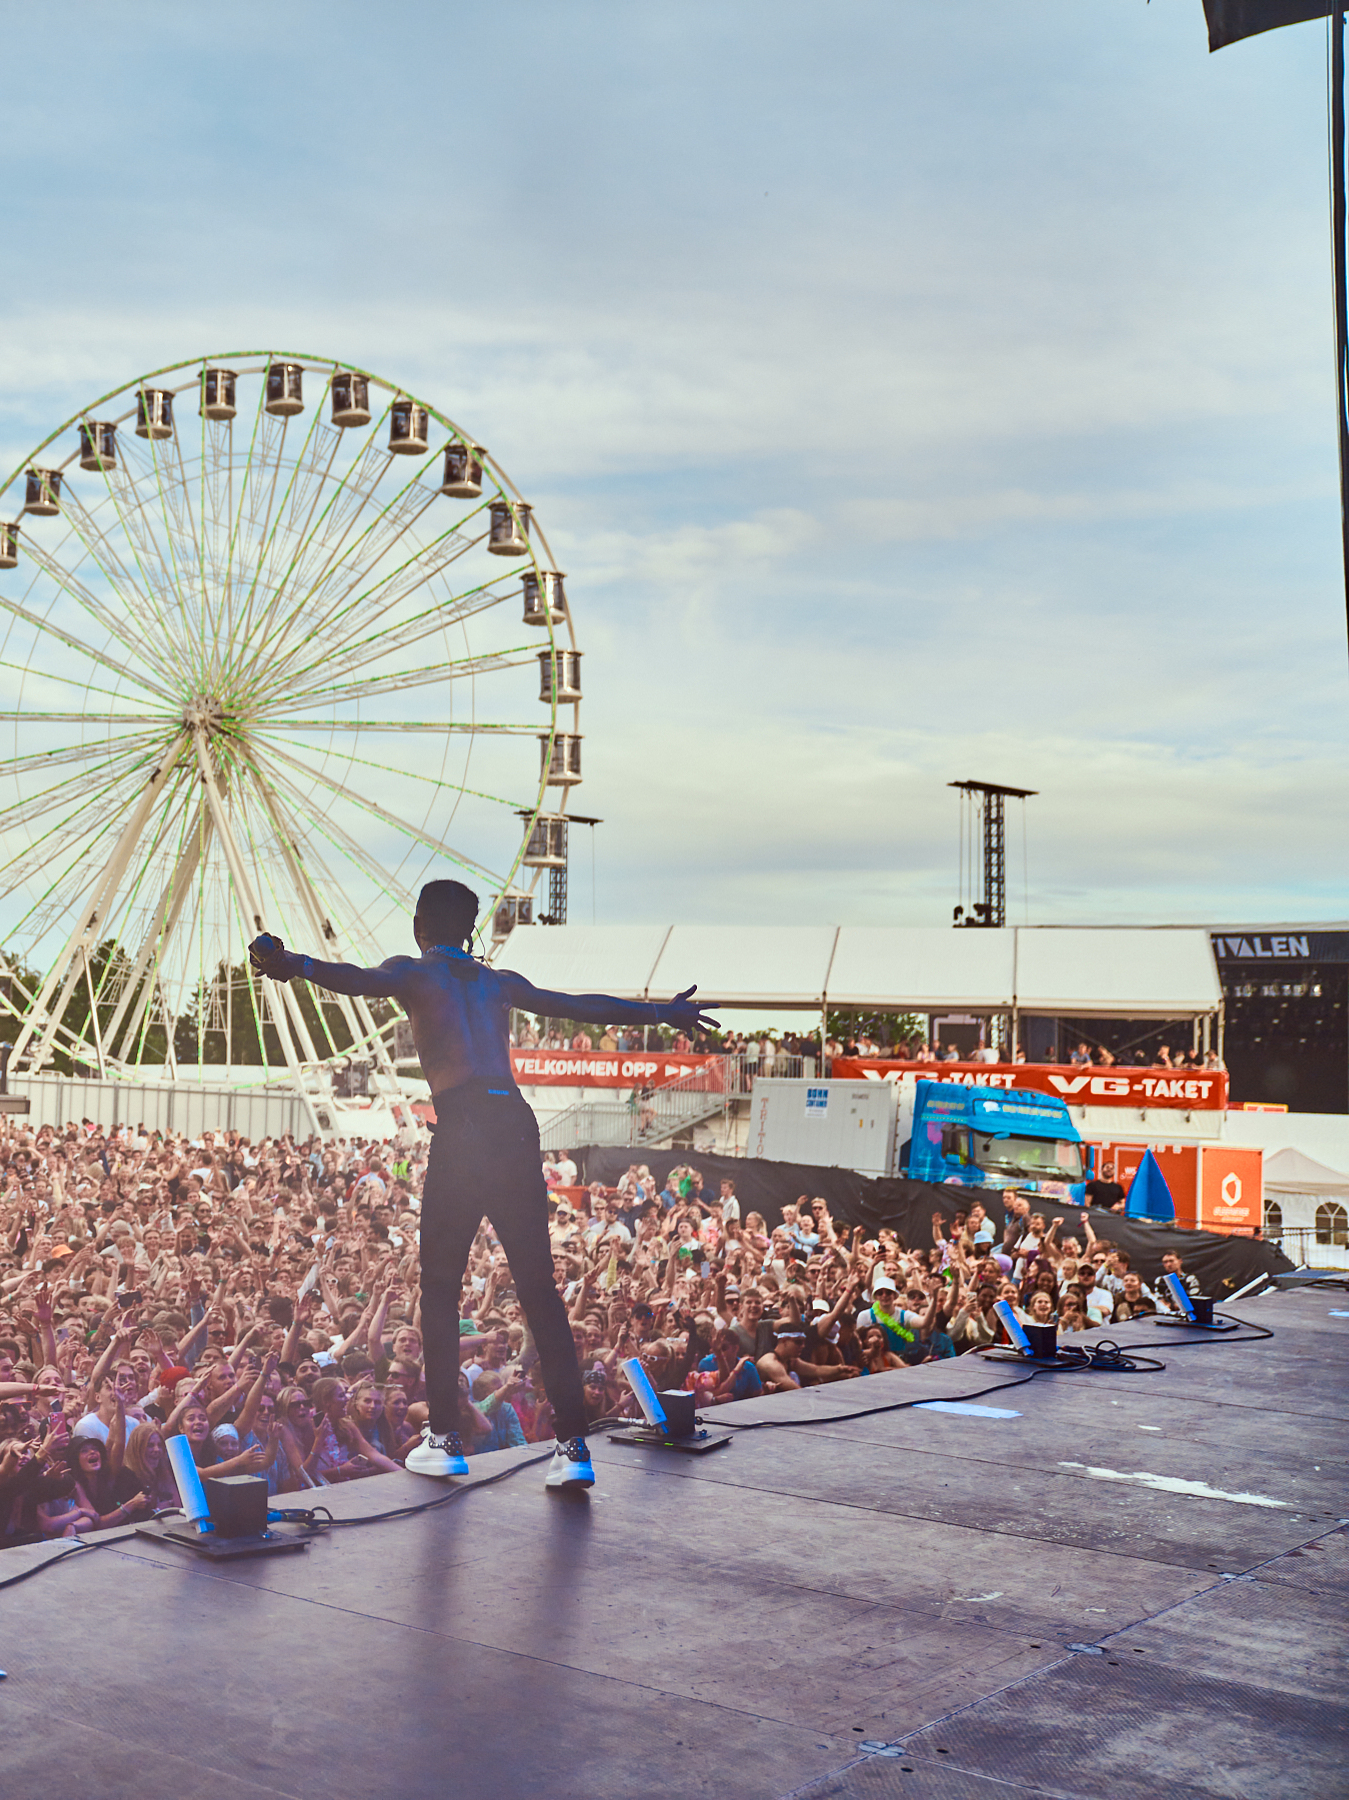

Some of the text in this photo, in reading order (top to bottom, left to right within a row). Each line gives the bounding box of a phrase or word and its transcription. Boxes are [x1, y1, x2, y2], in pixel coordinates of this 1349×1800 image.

[1211, 936, 1310, 958] IVALEN
[514, 1058, 658, 1078] VELKOMMEN OPP
[1047, 1075, 1213, 1099] VG-TAKET
